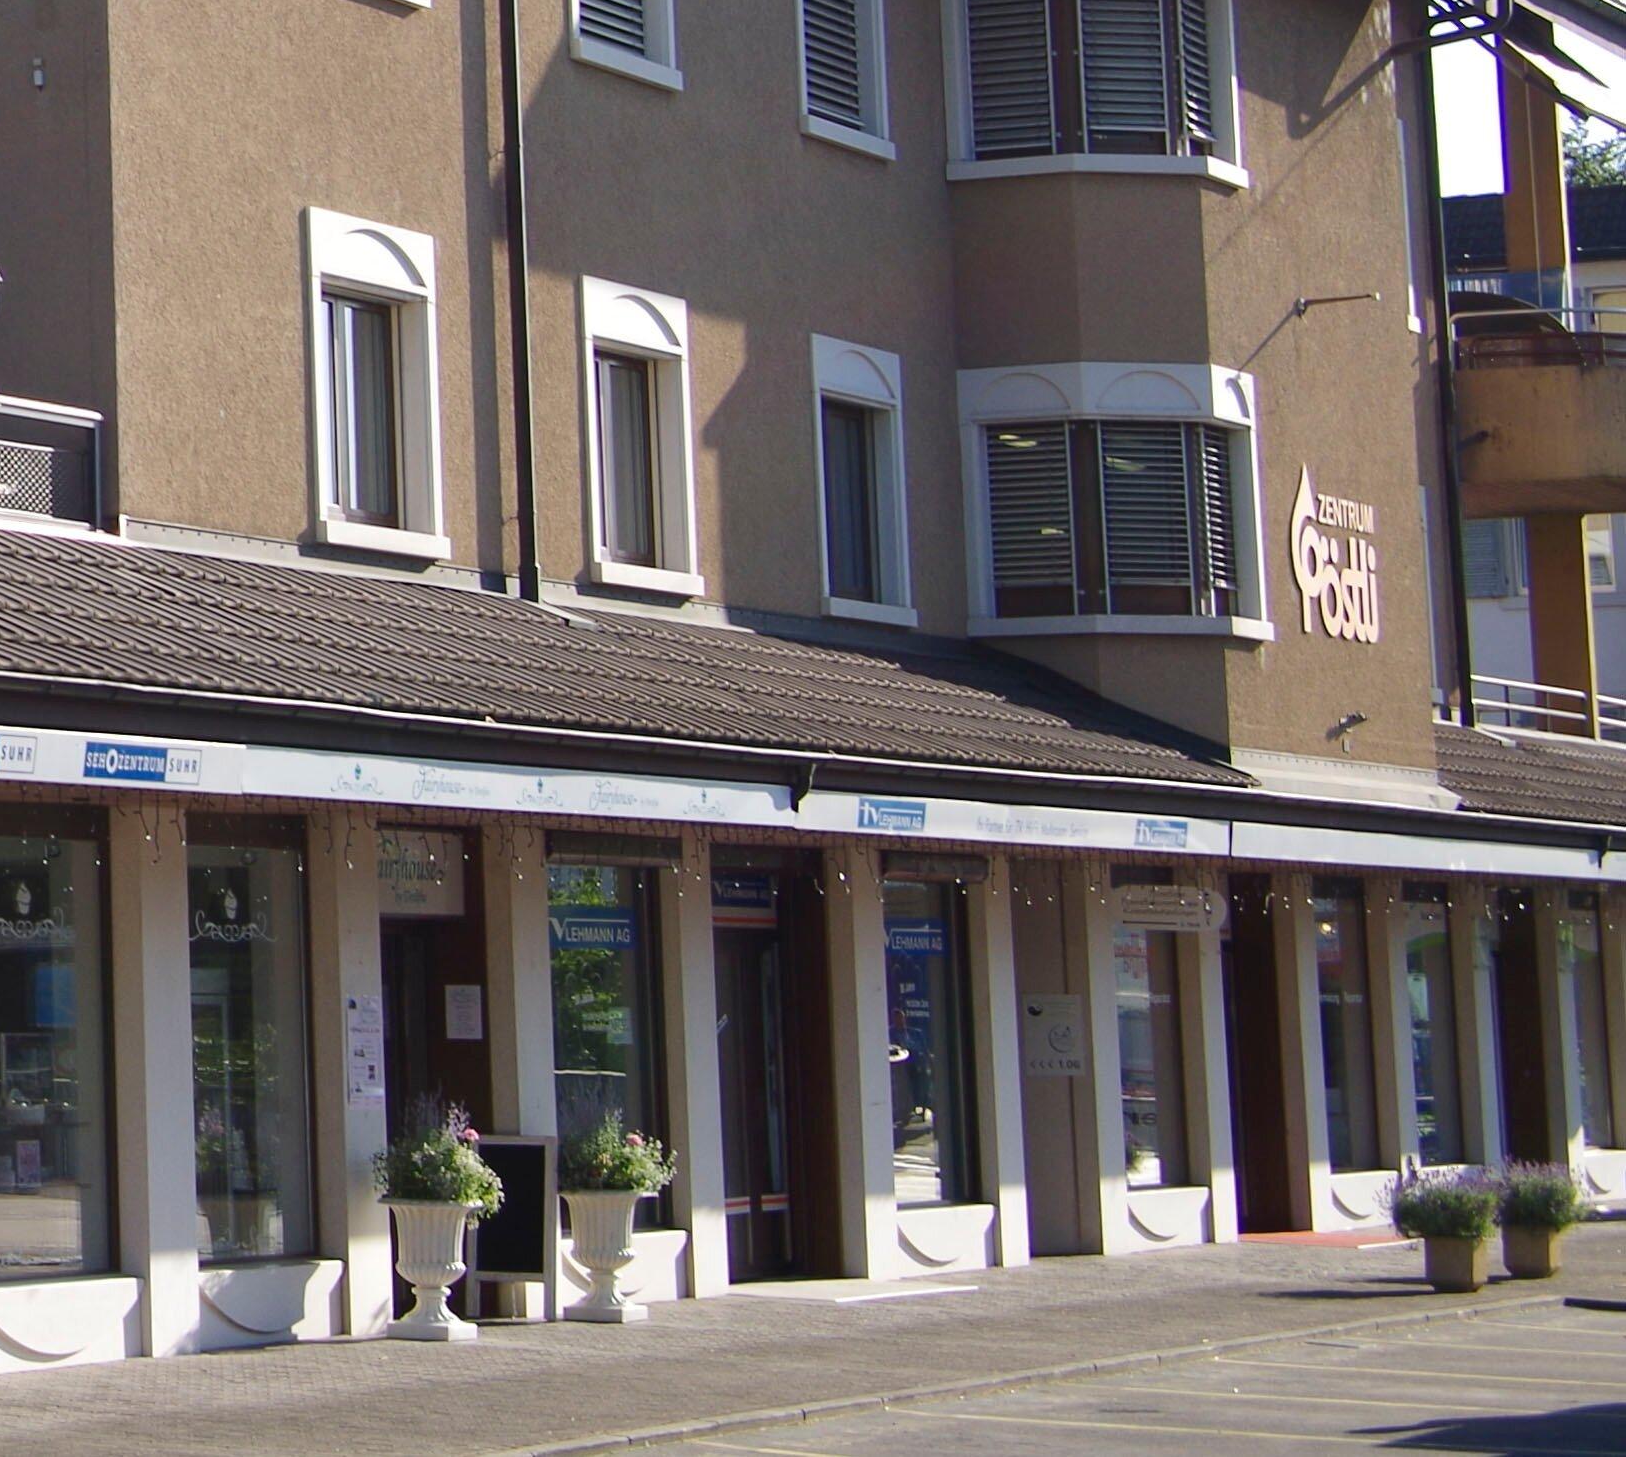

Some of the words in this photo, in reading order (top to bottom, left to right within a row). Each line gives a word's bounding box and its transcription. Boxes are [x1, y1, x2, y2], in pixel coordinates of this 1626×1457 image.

[1317, 493, 1374, 534] ZENTRUM
[0, 745, 32, 762] SUHR
[169, 758, 198, 773] SUHR
[565, 926, 614, 942] LEHMANN
[615, 928, 631, 943] AG
